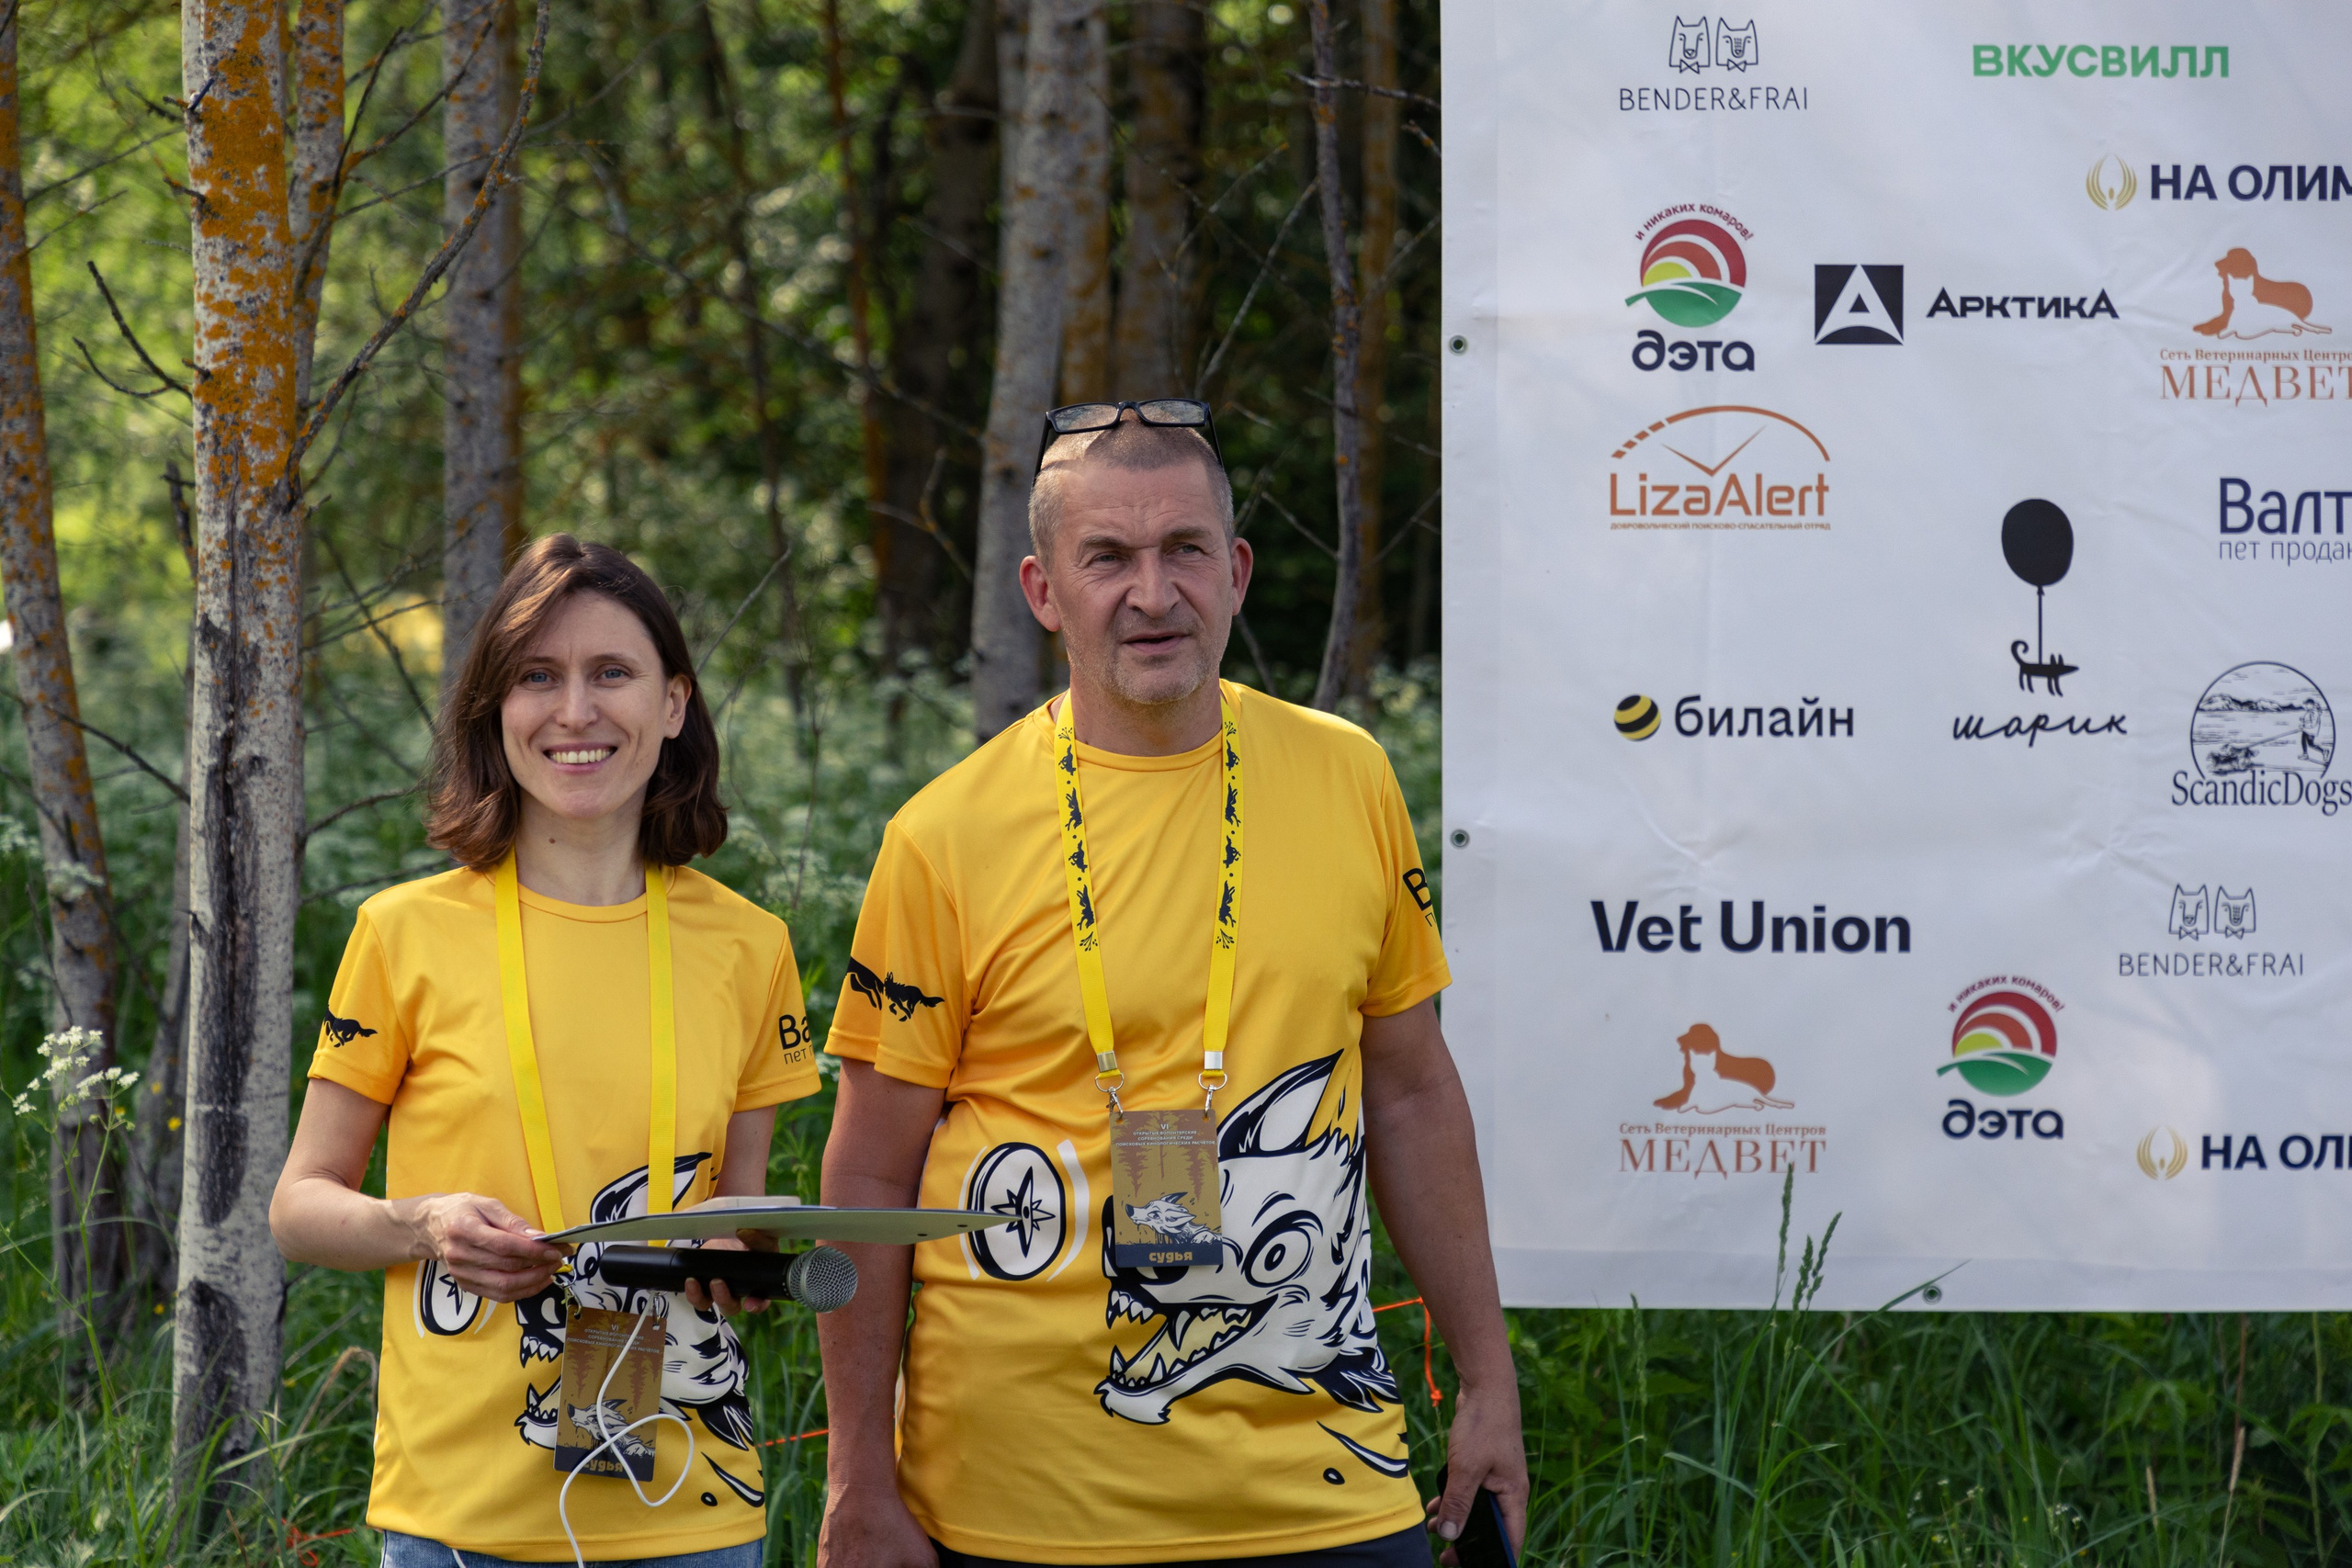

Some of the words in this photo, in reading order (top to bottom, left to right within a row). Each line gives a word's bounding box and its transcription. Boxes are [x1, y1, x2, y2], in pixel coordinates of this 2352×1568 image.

[1973, 44, 2229, 78] ВКУСВИЛЛ
[1620, 86, 1807, 111] BENDER&FRAI
[2151, 164, 2218, 200] НА
[1634, 230, 1645, 242] и
[1643, 203, 1696, 232] никаких
[1699, 203, 1754, 242] комаров!
[1632, 329, 1755, 372] дэта
[2160, 349, 2191, 361] Сеть
[2195, 349, 2299, 364] Ветеринарных
[1610, 473, 1830, 516] LizaAlert
[2220, 477, 2352, 535] Валт
[2220, 541, 2260, 560] пет
[1674, 694, 1854, 738] билайн
[1952, 713, 2128, 748] шарик
[2172, 770, 2352, 817] ScandicDogs
[1589, 899, 1702, 953] Vet
[1720, 899, 1911, 953] Union
[2120, 953, 2303, 976] BENDER&FRAI
[1947, 1001, 1957, 1013] и
[1956, 975, 2008, 1005] никаких
[2010, 975, 2065, 1013] комаров!
[784, 1047, 807, 1065] пет
[1619, 1122, 1652, 1134] Сеть
[1655, 1122, 1761, 1138] Ветеринарных
[1765, 1123, 1826, 1137] Центров
[1941, 1098, 2064, 1140] дэта
[1619, 1138, 1826, 1180] МЕДВЕТ
[2201, 1134, 2268, 1170] НА
[2278, 1134, 2352, 1170] ОЛ
[1148, 1251, 1193, 1263] судья
[583, 1459, 623, 1472] удья
